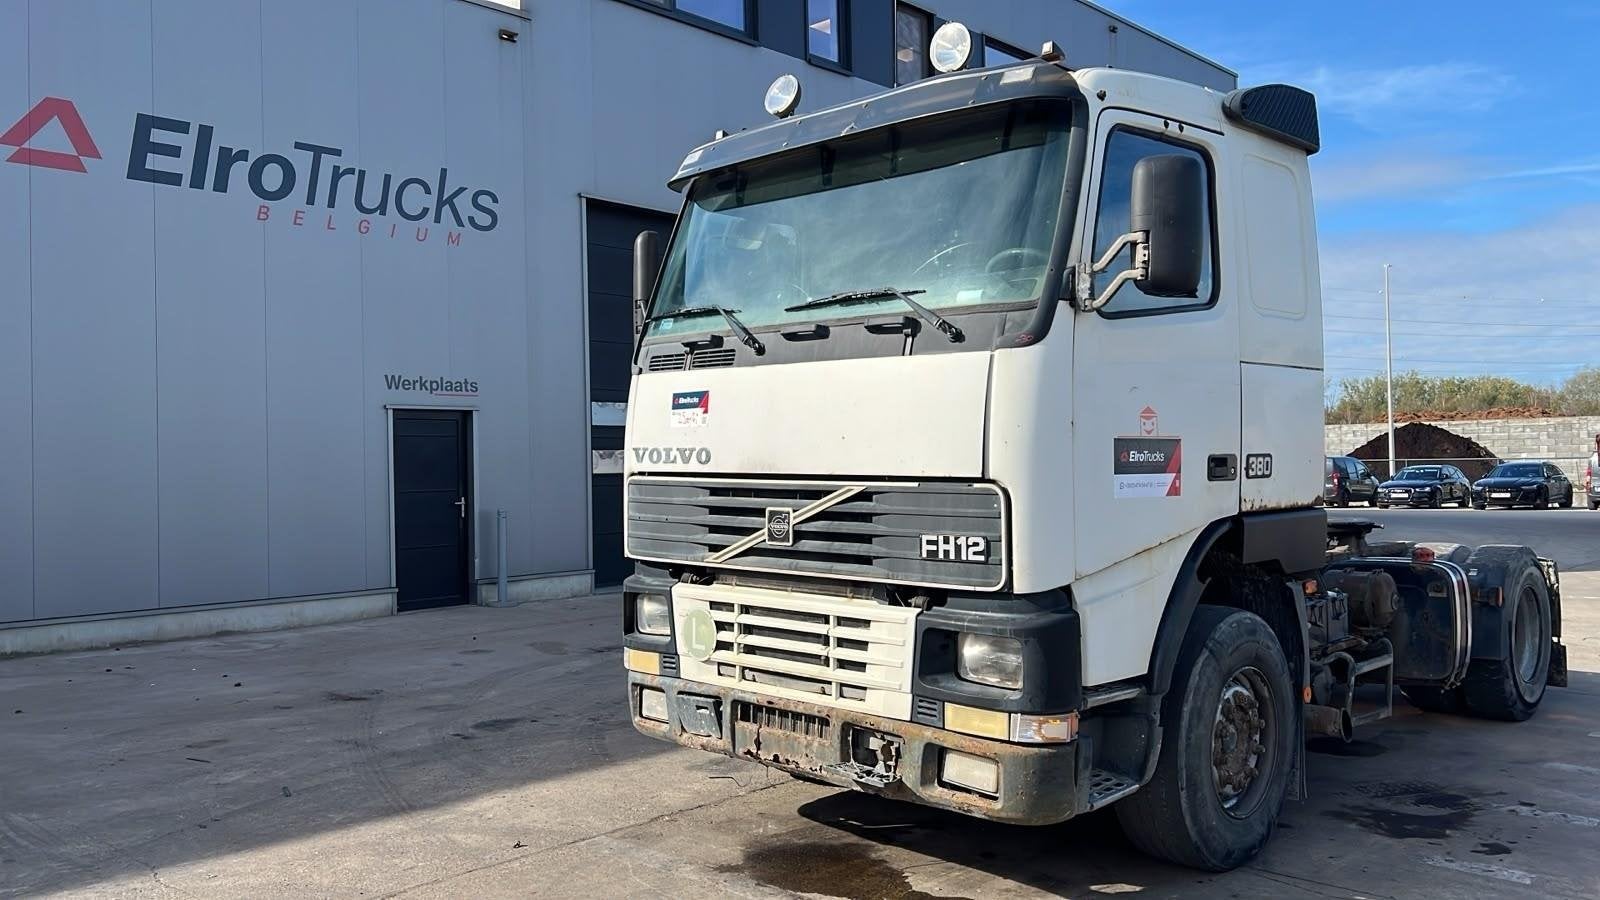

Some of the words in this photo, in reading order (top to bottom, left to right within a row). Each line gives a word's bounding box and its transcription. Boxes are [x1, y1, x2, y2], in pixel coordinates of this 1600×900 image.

[126, 113, 499, 232] ElroTrucks
[257, 205, 462, 247] BELGIUM
[384, 374, 479, 394] Werkplaats
[632, 447, 712, 465] VOLVO
[1129, 450, 1165, 462] ElroTrucks
[1249, 456, 1271, 477] 380
[921, 534, 985, 561] FH12
[692, 616, 706, 650] L
